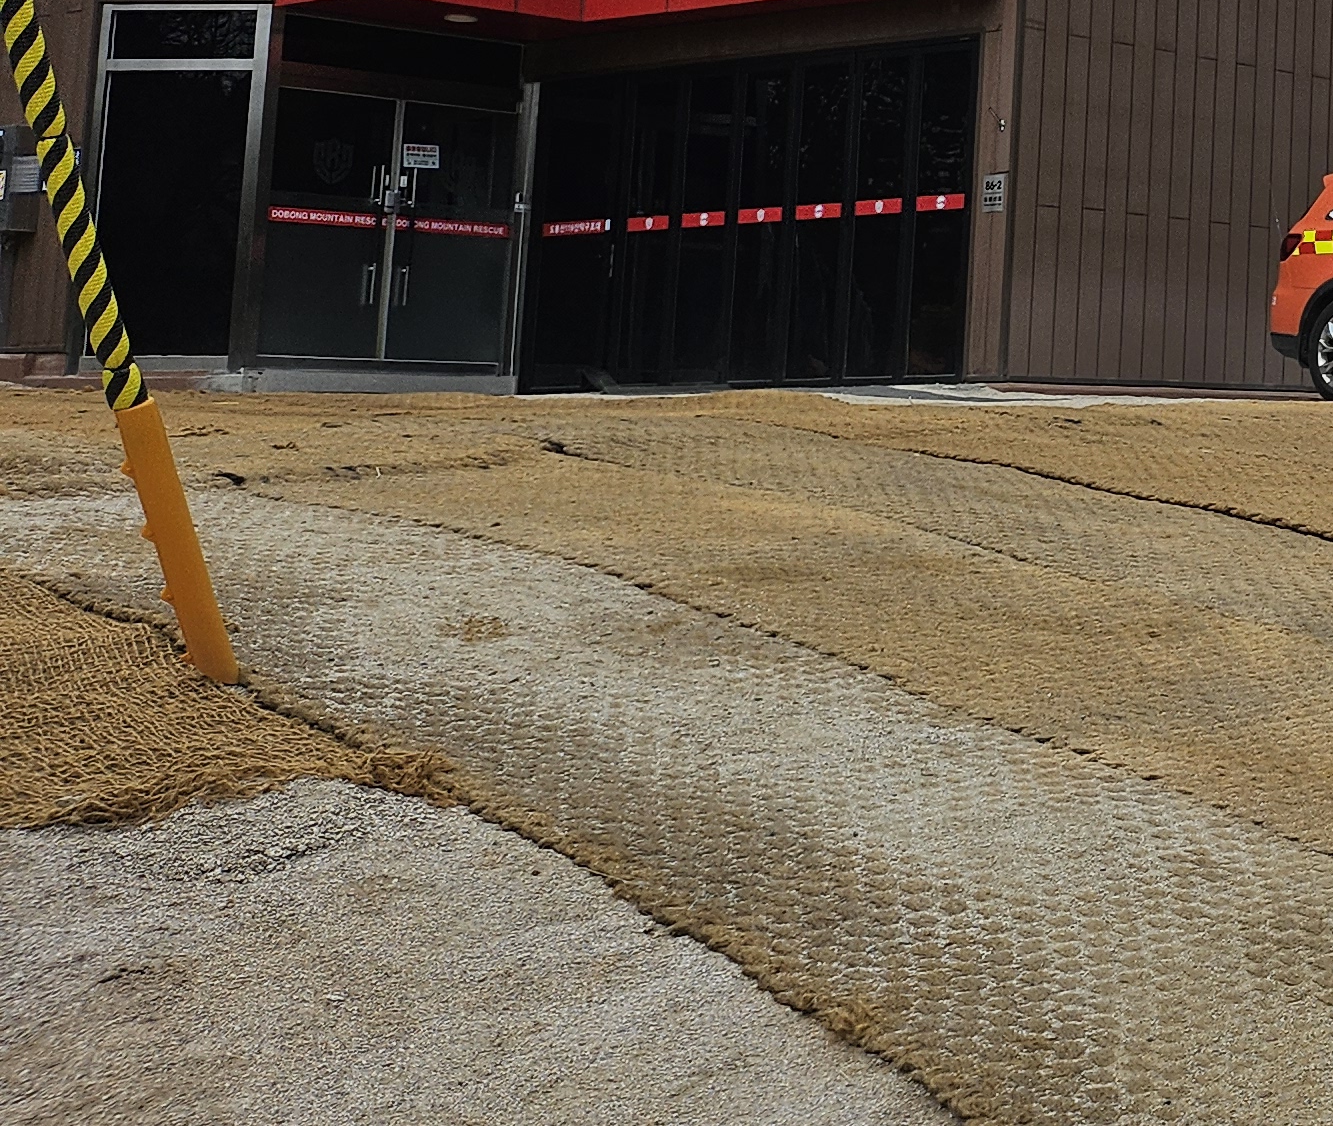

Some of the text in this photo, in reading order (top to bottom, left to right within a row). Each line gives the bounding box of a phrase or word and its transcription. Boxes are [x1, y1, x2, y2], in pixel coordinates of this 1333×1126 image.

[985, 180, 1002, 191] 86-2
[271, 209, 387, 226] DOBONG MOUNTAIN RESCE
[431, 222, 472, 232] MOUNTAIN
[473, 225, 504, 235] RESCUE
